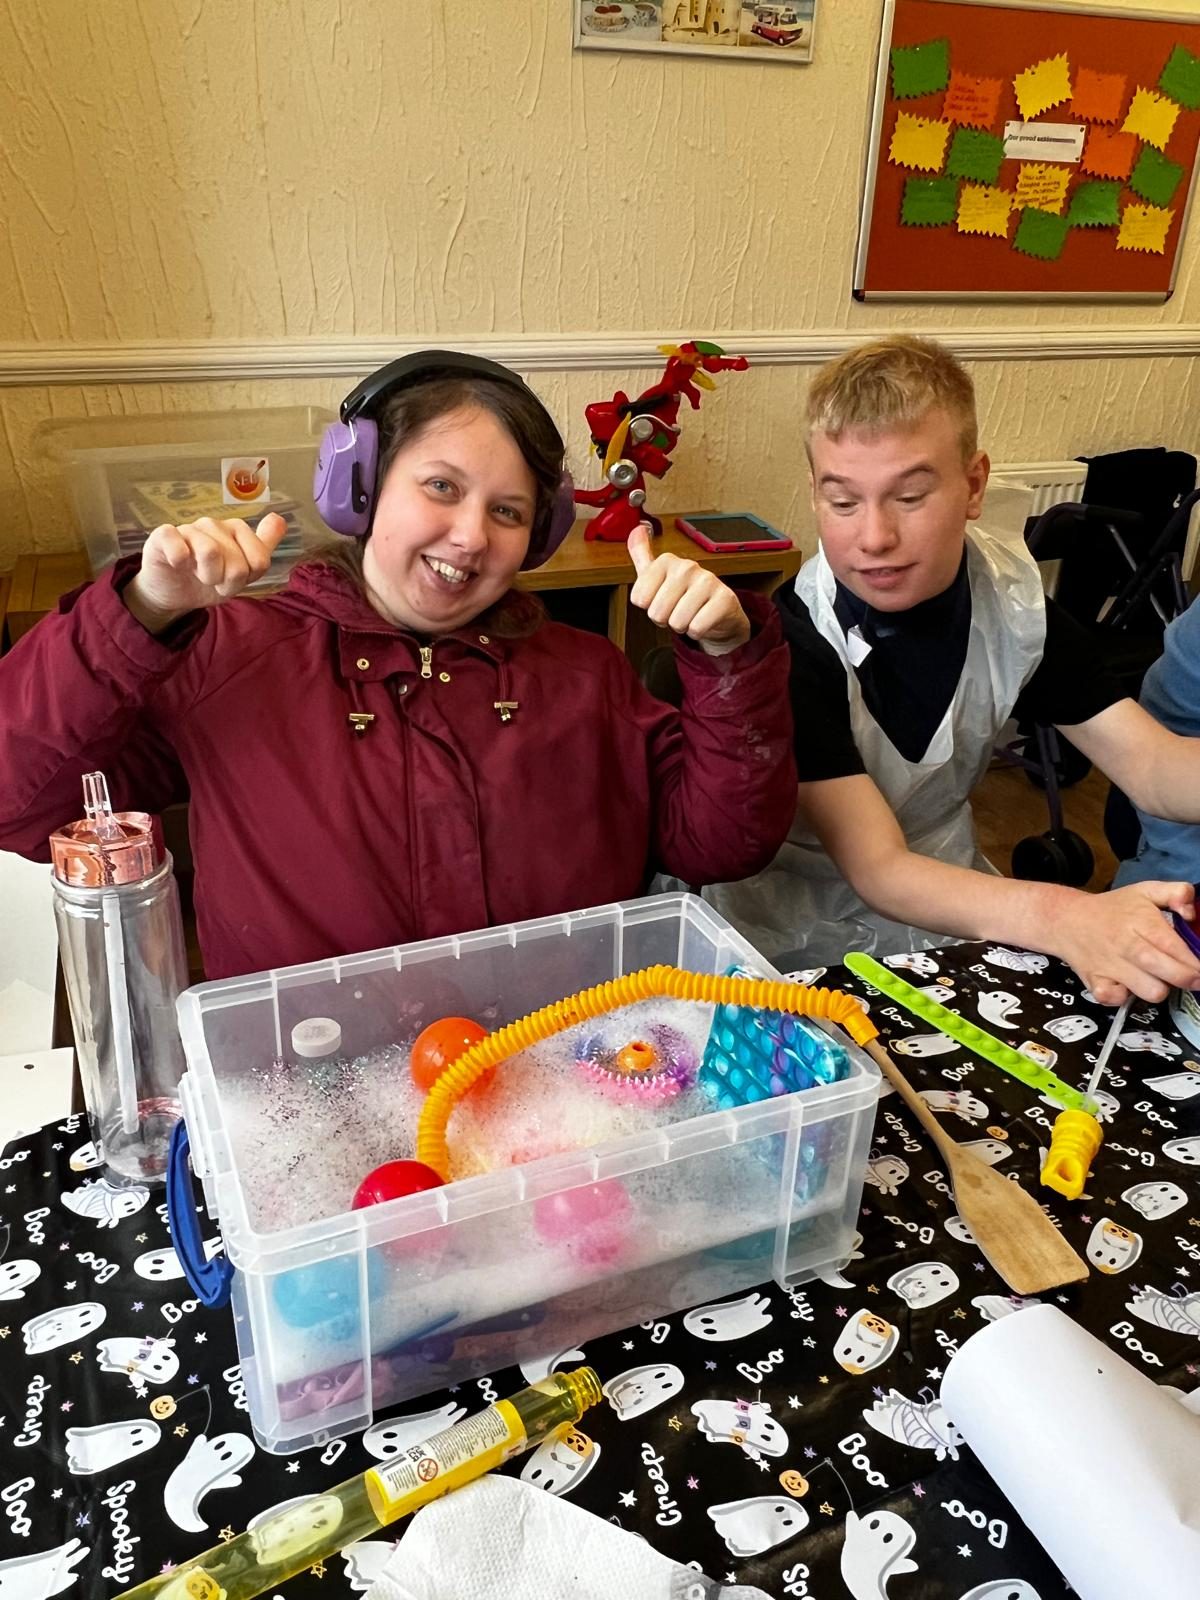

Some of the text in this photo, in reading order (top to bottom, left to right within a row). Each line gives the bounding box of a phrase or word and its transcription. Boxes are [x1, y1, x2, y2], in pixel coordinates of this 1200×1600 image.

[968, 963, 1001, 984] Boo
[1034, 987, 1075, 1005] Boo
[880, 1007, 915, 1029] Boo
[941, 1062, 976, 1082] Boo
[1024, 1106, 1054, 1132] Bo
[1134, 1101, 1178, 1129] Boo
[883, 1112, 922, 1153] Creep
[0, 1150, 31, 1169] oo
[1104, 1142, 1155, 1167] Boo
[923, 1170, 955, 1201] Bo
[23, 1207, 51, 1245] Boo
[884, 1215, 935, 1244] Boo
[75, 1251, 120, 1284] Boo
[160, 1299, 202, 1324] Bo
[640, 1320, 671, 1344] Bo
[1109, 1321, 1164, 1367] Boo
[736, 1348, 784, 1384] Boo
[477, 1377, 499, 1405] oo
[13, 1375, 51, 1447] Creep
[837, 1432, 890, 1488] Boo
[641, 1442, 683, 1526] Creep
[1, 1476, 36, 1537] Boo
[100, 1479, 141, 1583] Spooky
[940, 1499, 1008, 1549] Boo
